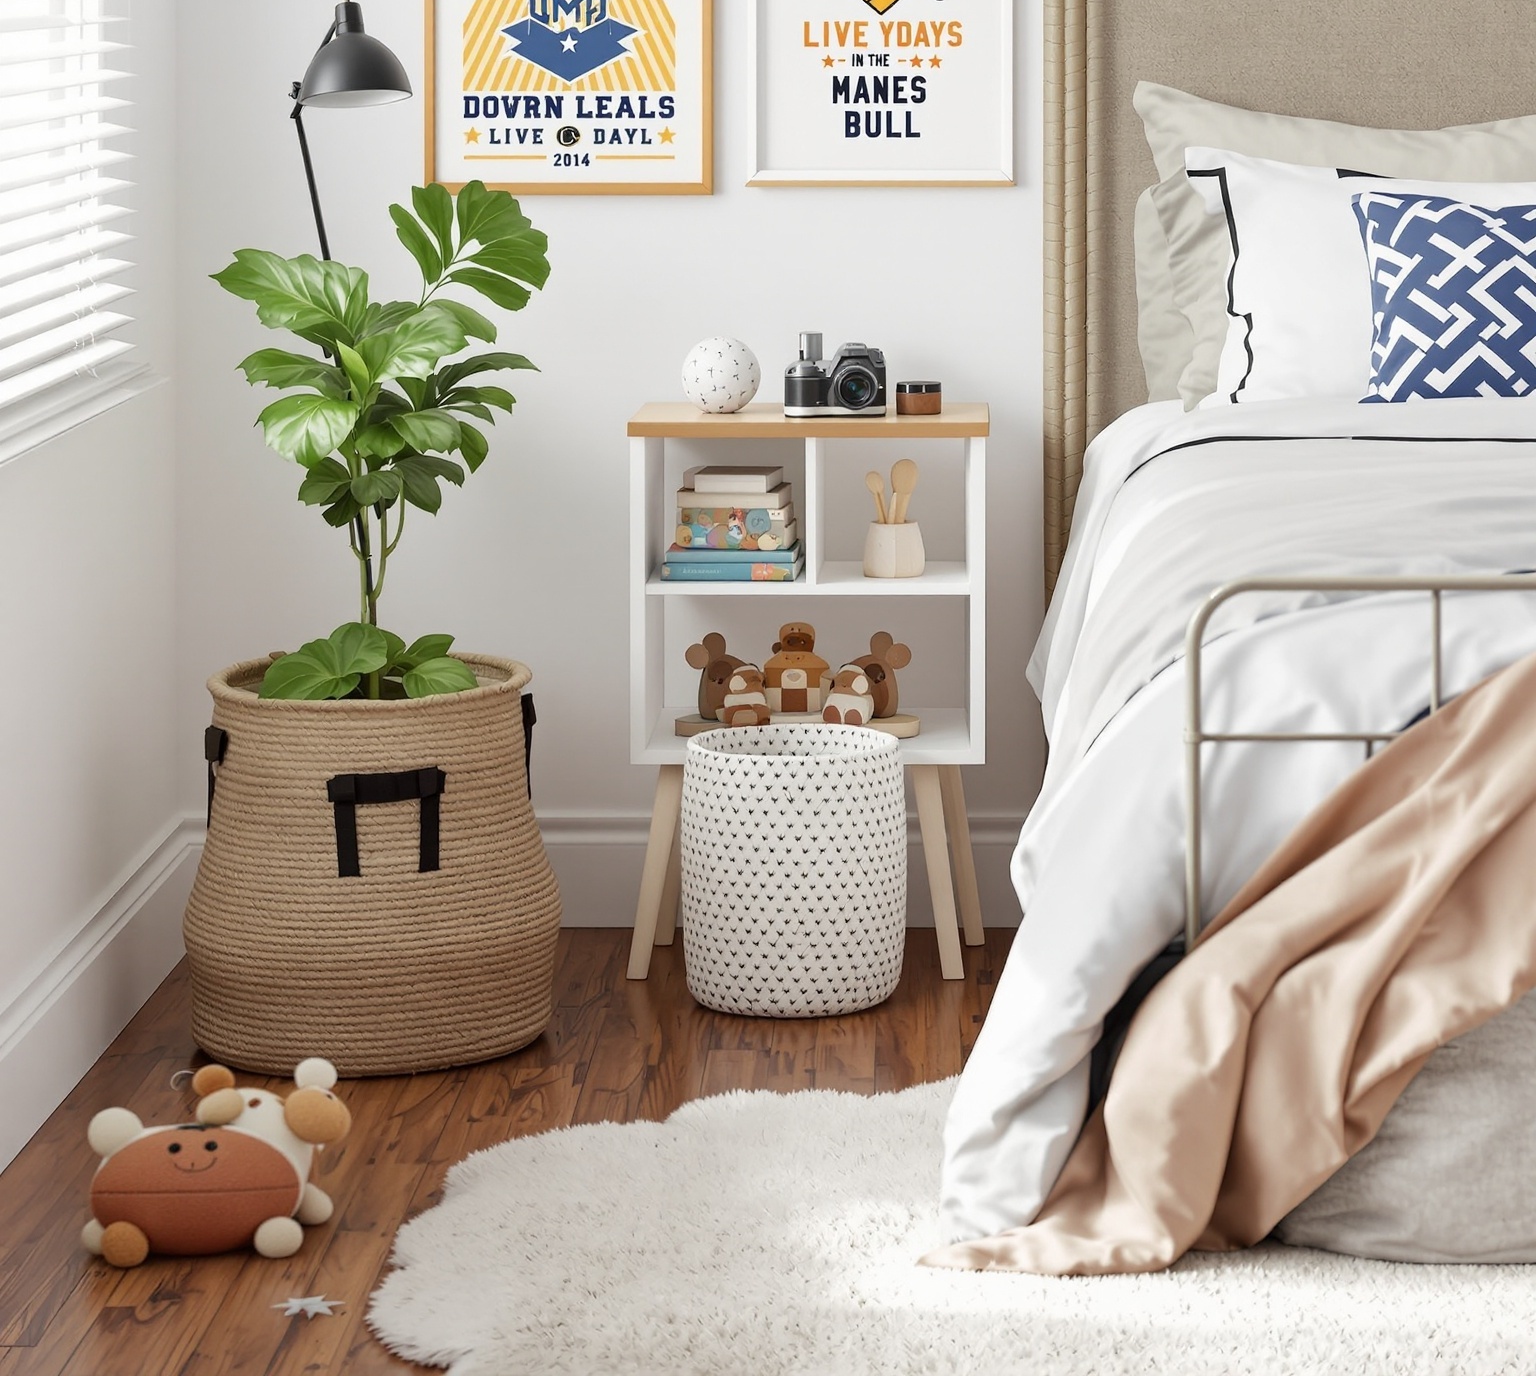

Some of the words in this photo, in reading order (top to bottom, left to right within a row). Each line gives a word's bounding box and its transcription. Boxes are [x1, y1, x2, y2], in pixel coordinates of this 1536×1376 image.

[803, 21, 868, 48] LIVE
[879, 21, 963, 48] YDAYS
[851, 53, 865, 68] IN
[867, 53, 890, 68] THE
[832, 75, 927, 104] MANES
[575, 95, 676, 119] LEALS
[844, 110, 921, 138] BULL
[489, 128, 544, 145] LIVE
[593, 128, 652, 145] DAYL
[553, 153, 590, 167] 2014
